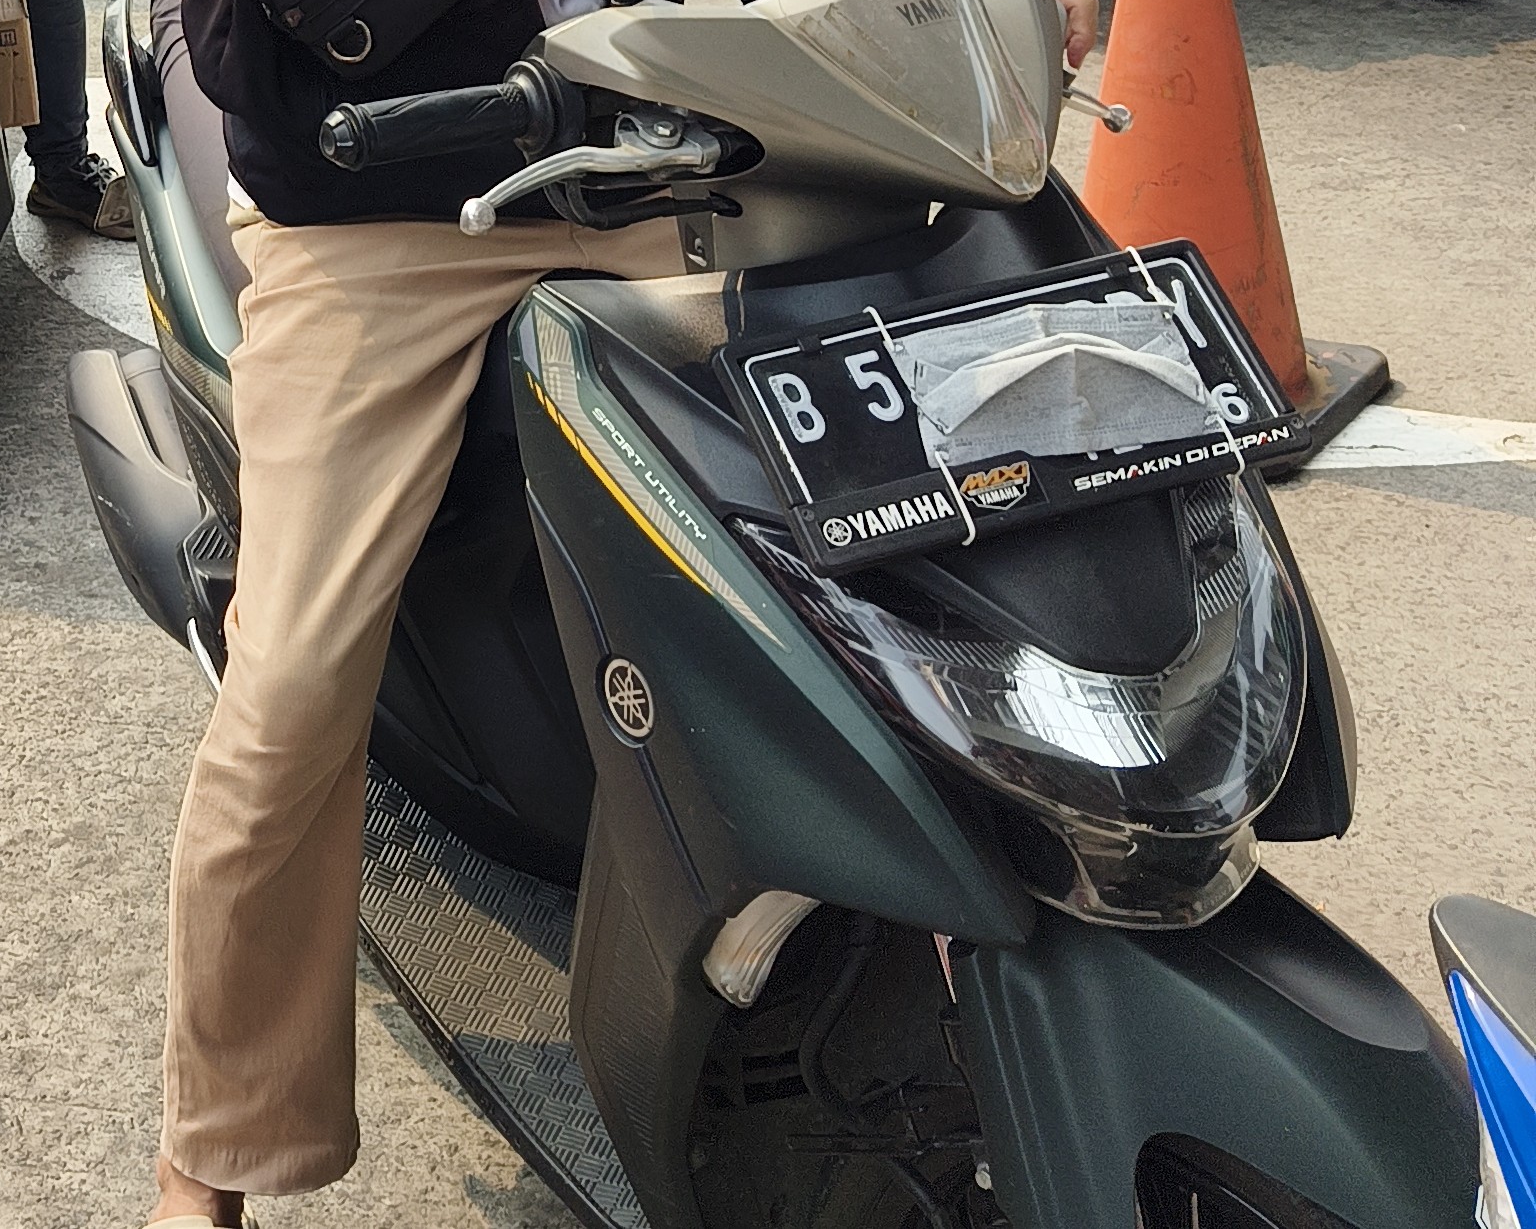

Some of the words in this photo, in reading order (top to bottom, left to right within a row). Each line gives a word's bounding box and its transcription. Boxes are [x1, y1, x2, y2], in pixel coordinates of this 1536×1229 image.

[768, 371, 827, 444] B
[591, 407, 646, 468] SPORT
[644, 470, 707, 540] UTILITY
[961, 461, 1029, 493] MAXI
[1073, 453, 1182, 492] SEMAKIN
[1186, 446, 1209, 464] DI
[1212, 426, 1290, 457] DEPAN
[846, 490, 956, 539] YAMAHA
[977, 485, 1021, 506] YAMAHA
